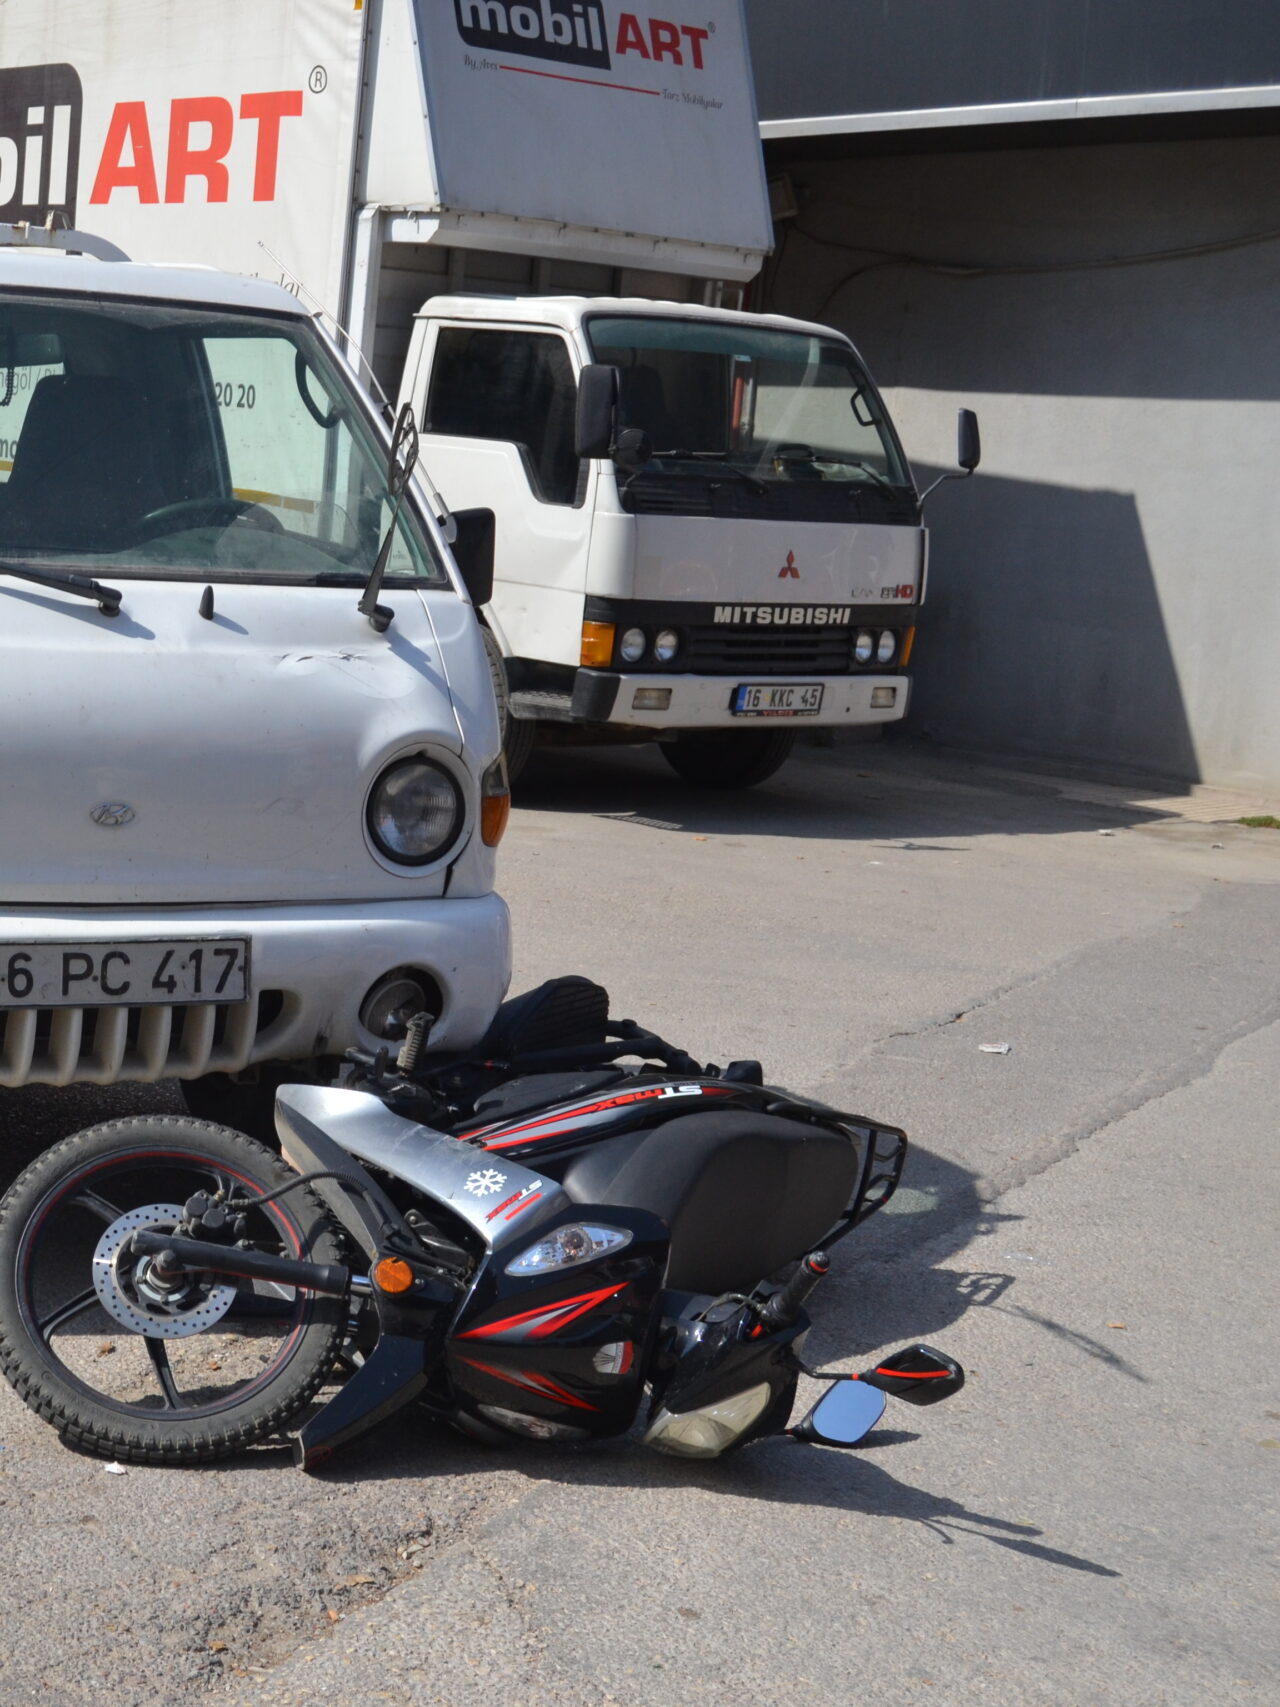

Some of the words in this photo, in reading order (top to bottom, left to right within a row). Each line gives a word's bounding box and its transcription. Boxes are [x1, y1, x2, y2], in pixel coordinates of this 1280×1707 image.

[461, 0, 602, 51] mobil
[616, 13, 709, 70] ART
[89, 90, 303, 205] ART
[236, 383, 256, 409] 20
[714, 606, 851, 625] MITSUBISHI
[746, 689, 761, 708] 16
[769, 688, 794, 708] KKC
[801, 688, 819, 707] 45
[62, 951, 131, 997] PC
[151, 949, 239, 994] 417
